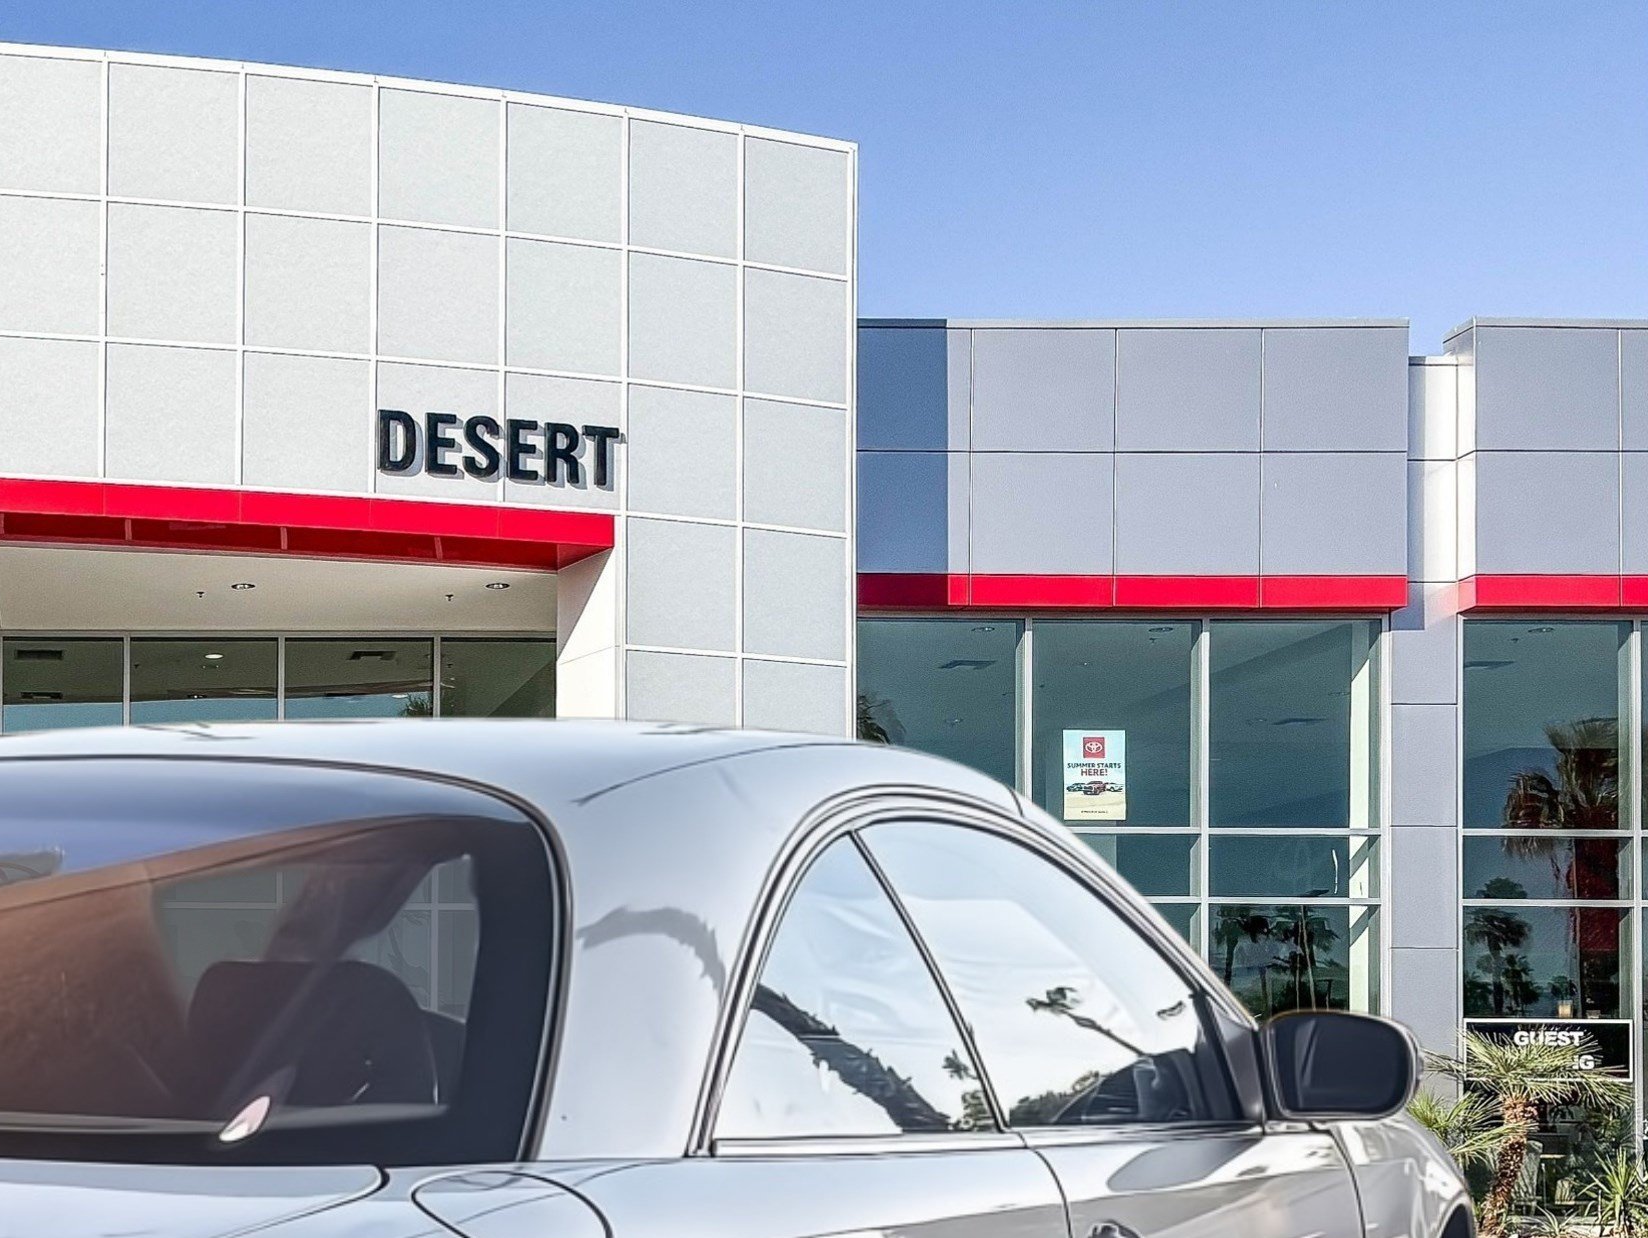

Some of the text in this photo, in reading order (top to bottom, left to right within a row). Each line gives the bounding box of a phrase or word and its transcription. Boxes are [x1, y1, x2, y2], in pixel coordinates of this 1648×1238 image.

[376, 408, 621, 487] DESERT
[1080, 768, 1108, 777] HERE!
[1513, 1030, 1585, 1047] GUEST
